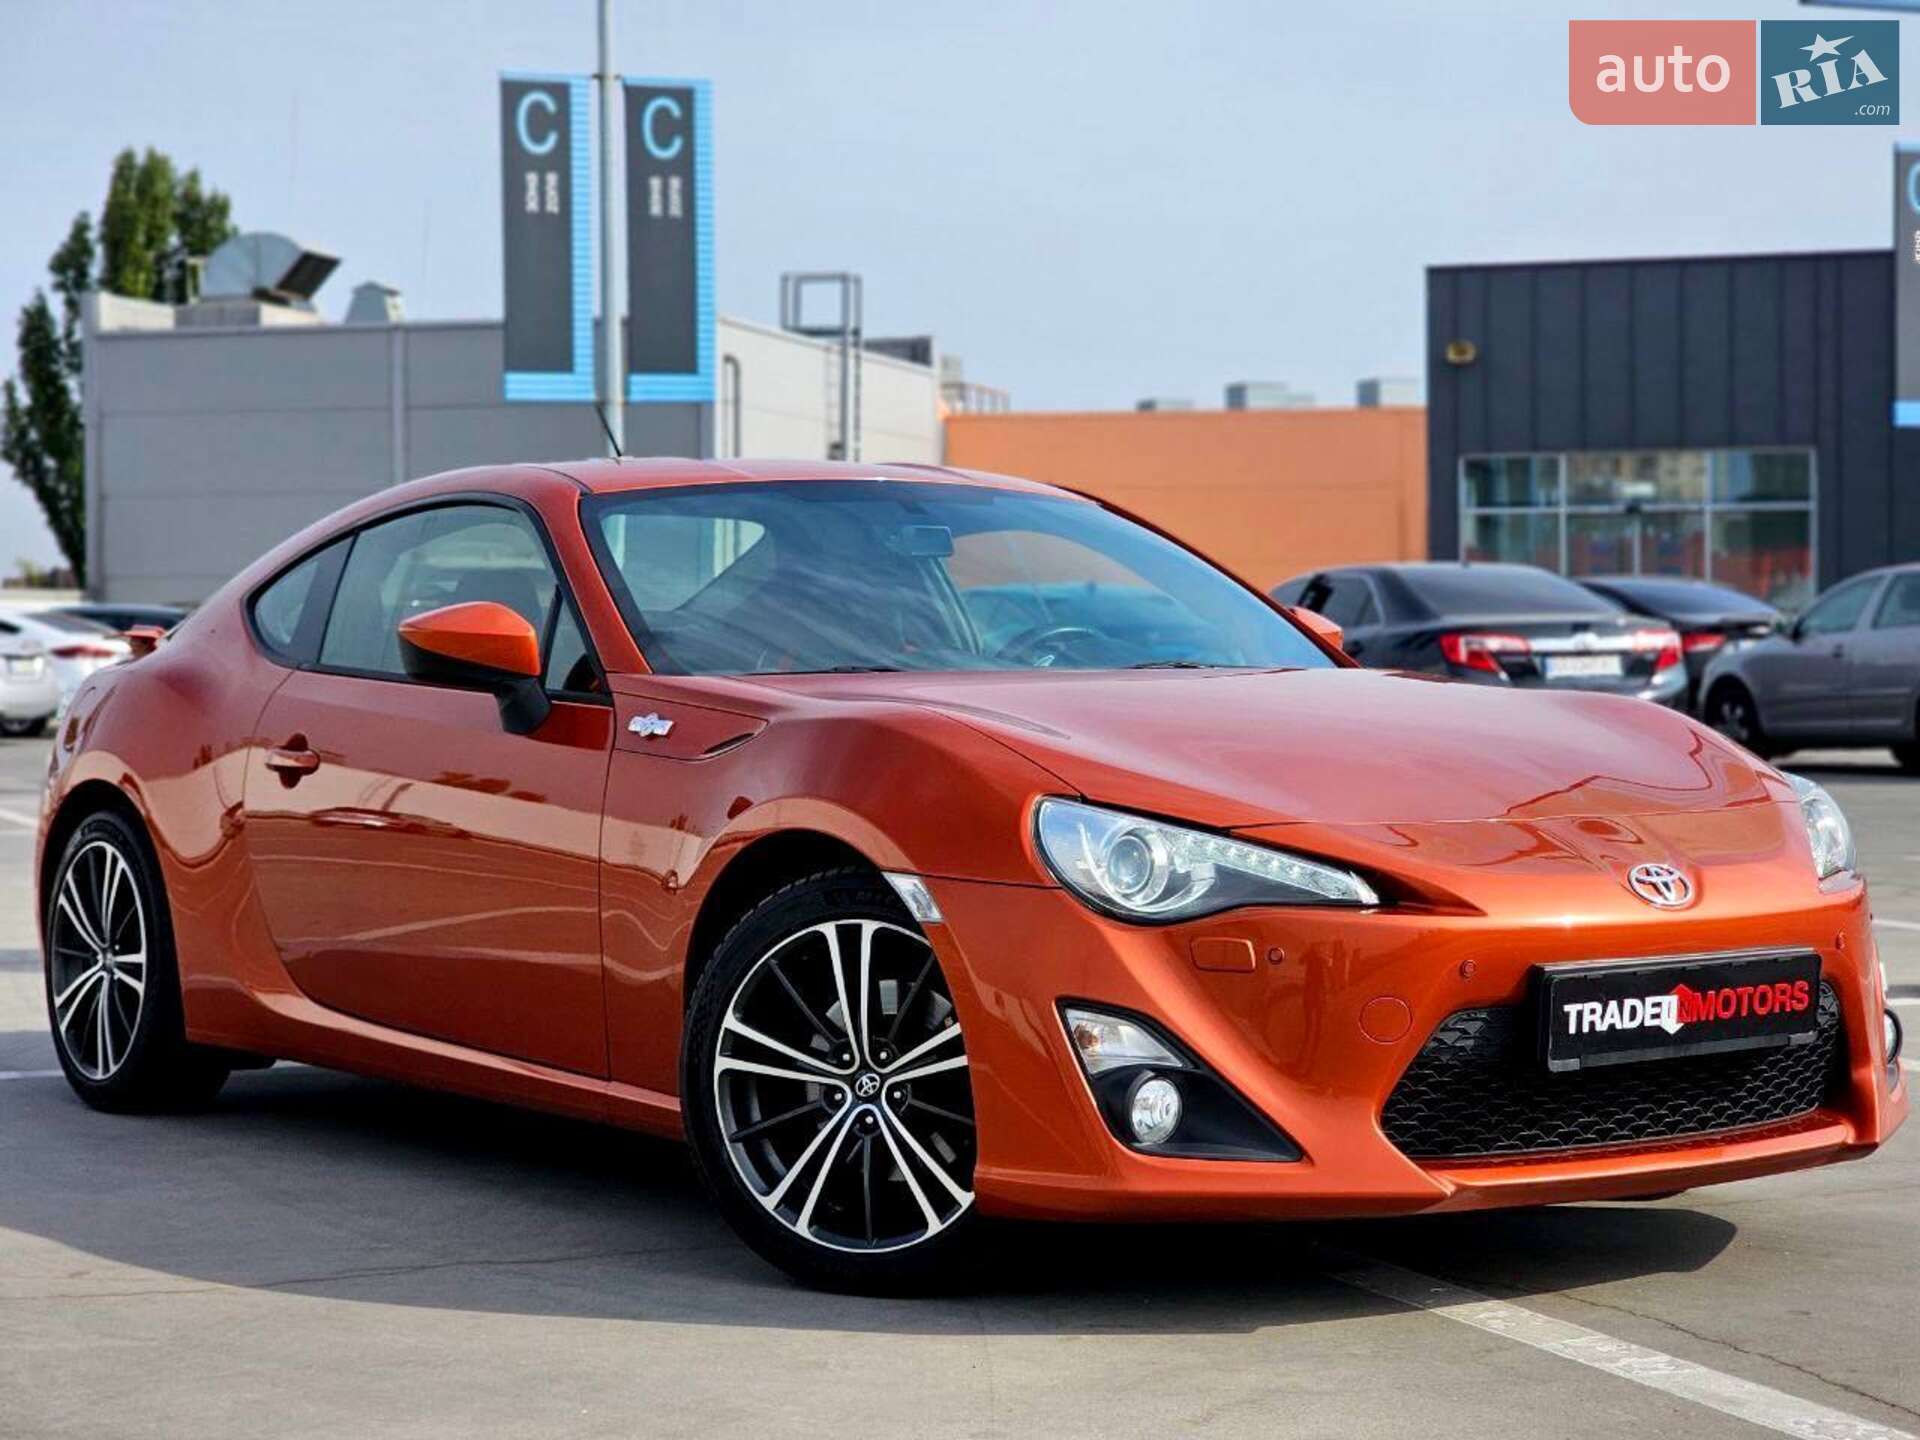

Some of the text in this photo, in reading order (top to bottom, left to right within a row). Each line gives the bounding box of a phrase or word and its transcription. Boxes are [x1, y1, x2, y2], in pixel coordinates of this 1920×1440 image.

[516, 90, 558, 155] C
[642, 96, 684, 160] C
[1563, 995, 1661, 1034] TRADE
[1693, 980, 1809, 1022] MOTORS
